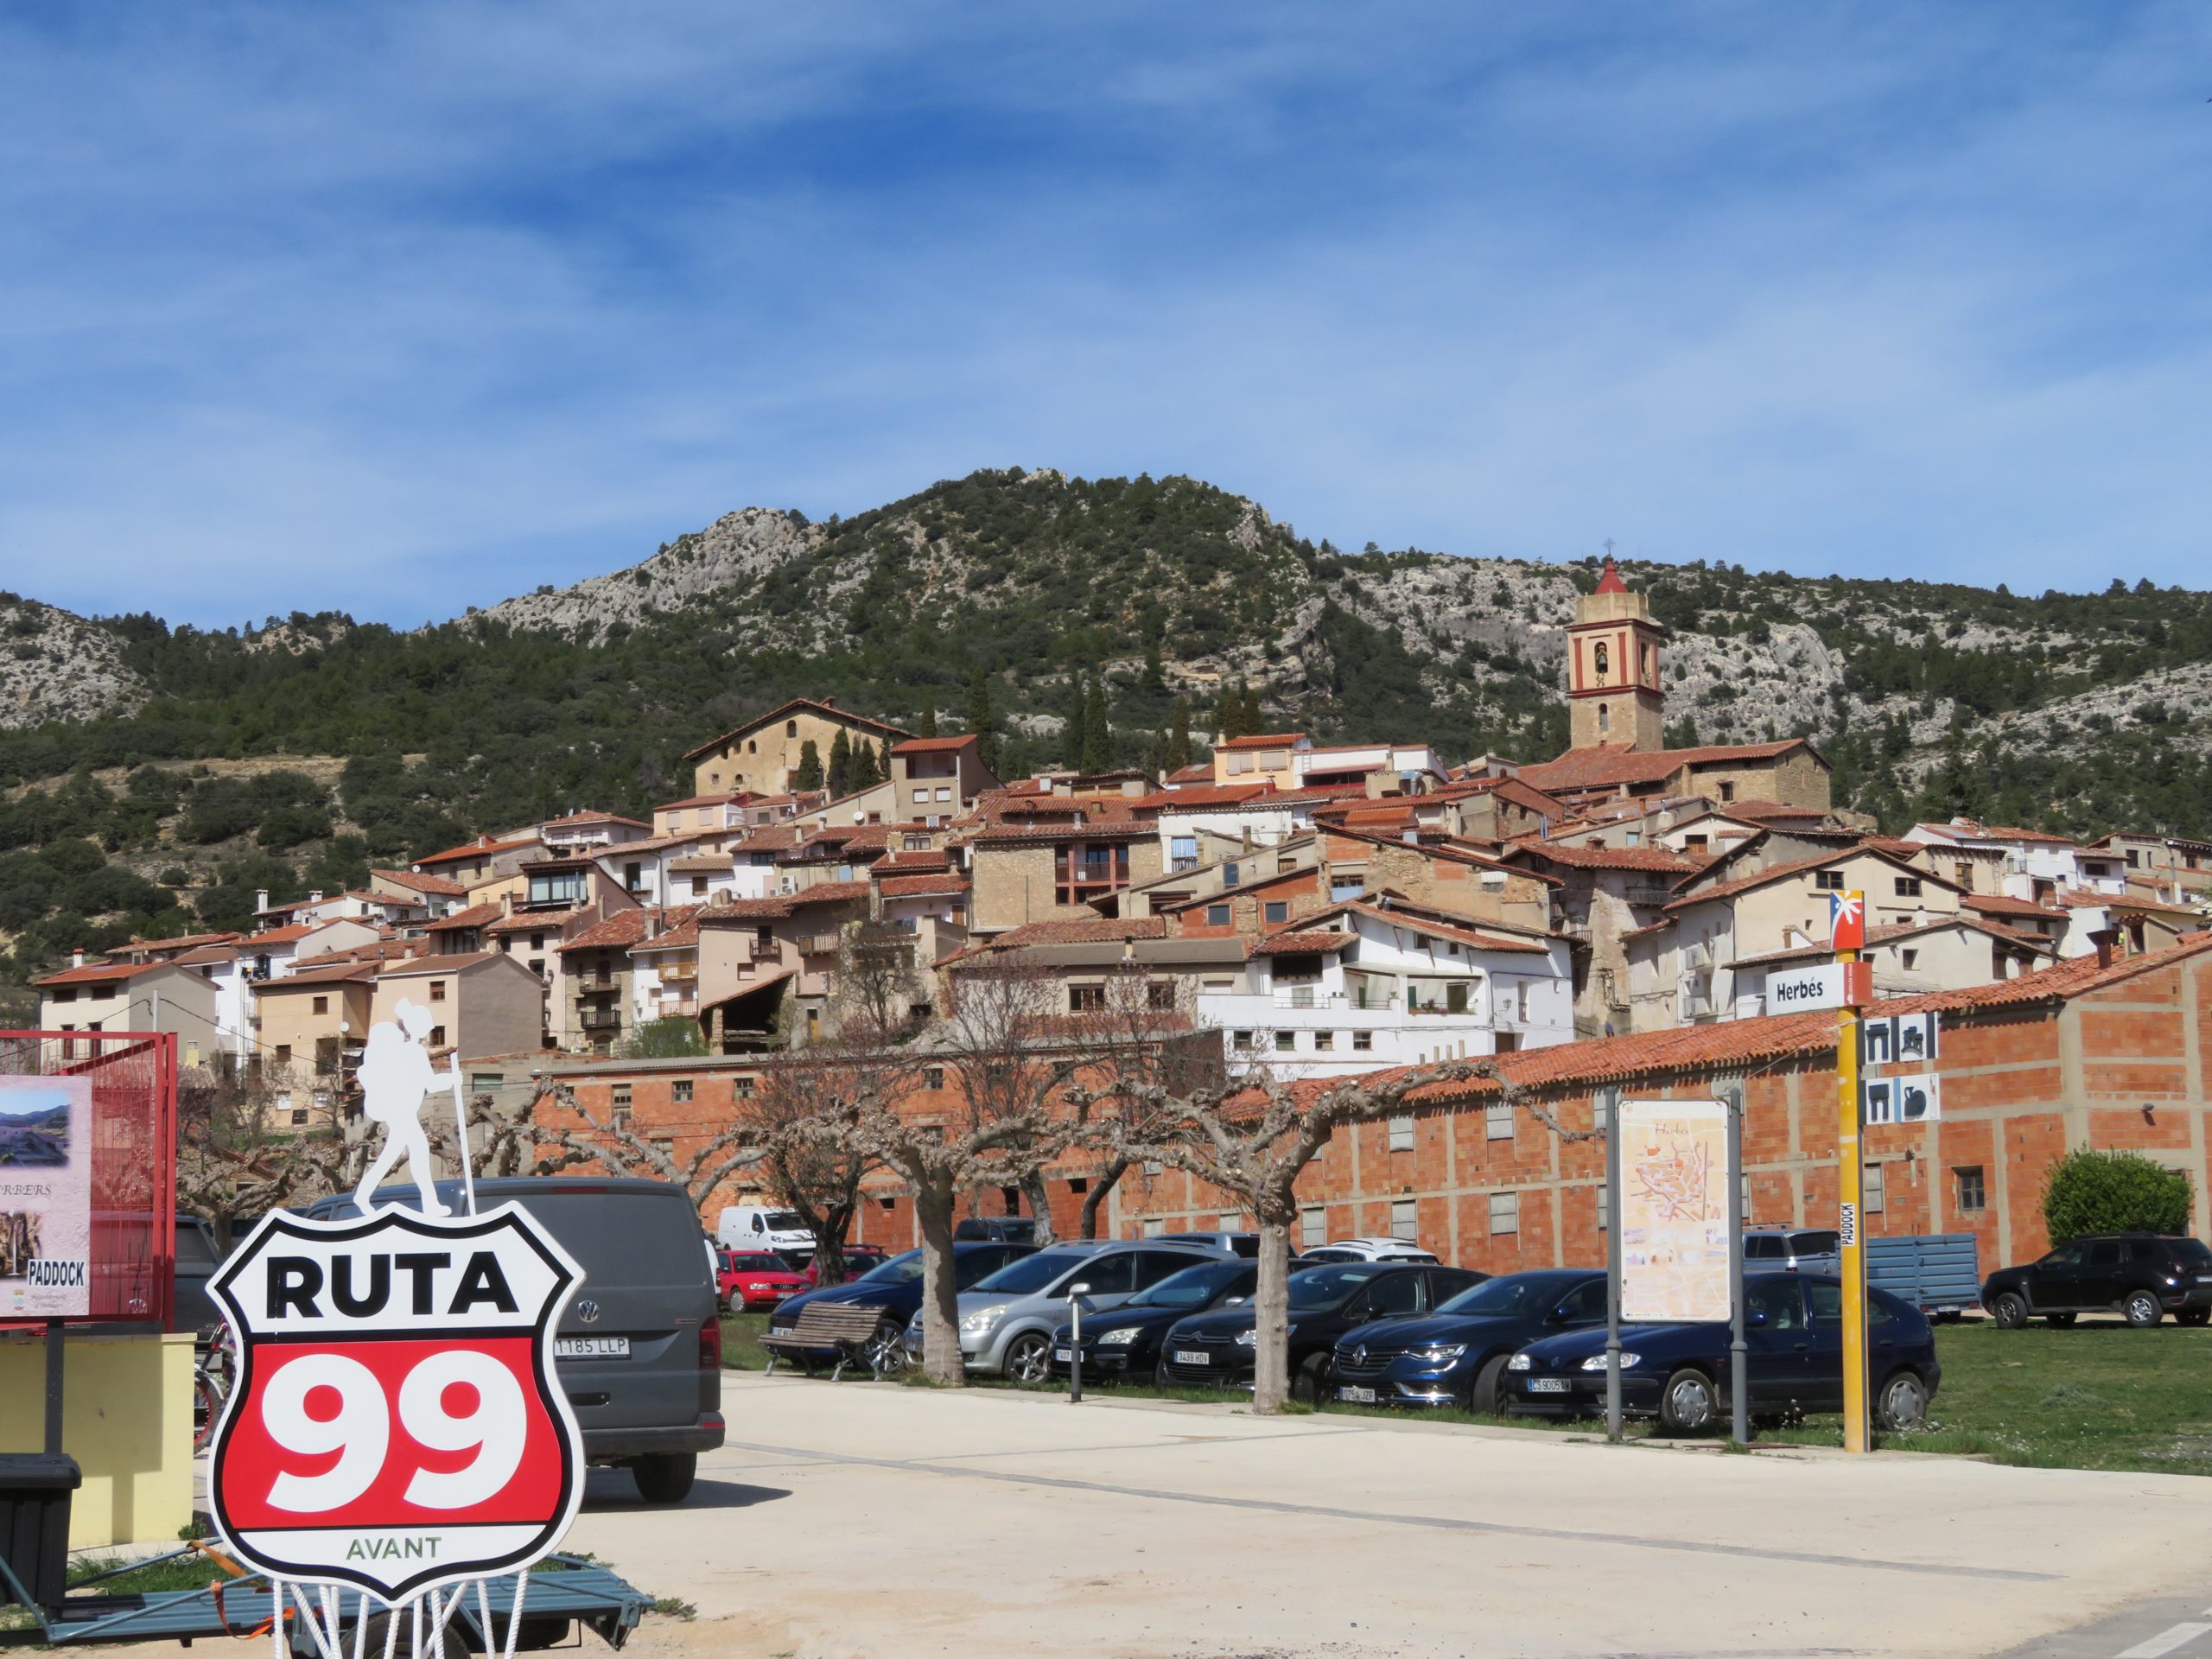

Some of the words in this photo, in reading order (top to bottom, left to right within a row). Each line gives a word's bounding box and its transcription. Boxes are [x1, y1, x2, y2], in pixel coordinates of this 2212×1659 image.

[1777, 976, 1823, 1002] Herbés
[1840, 1204, 1853, 1245] PADDOCK
[29, 1261, 84, 1287] PADDOCK
[266, 1250, 520, 1319] RUTA
[557, 1339, 594, 1354] 1185
[599, 1338, 626, 1353] LLP
[1179, 1352, 1194, 1363] 3439
[1195, 1353, 1208, 1363] HDV
[1541, 1380, 1560, 1390] 9005
[261, 1350, 527, 1513] 99
[346, 1536, 442, 1560] AVANT
